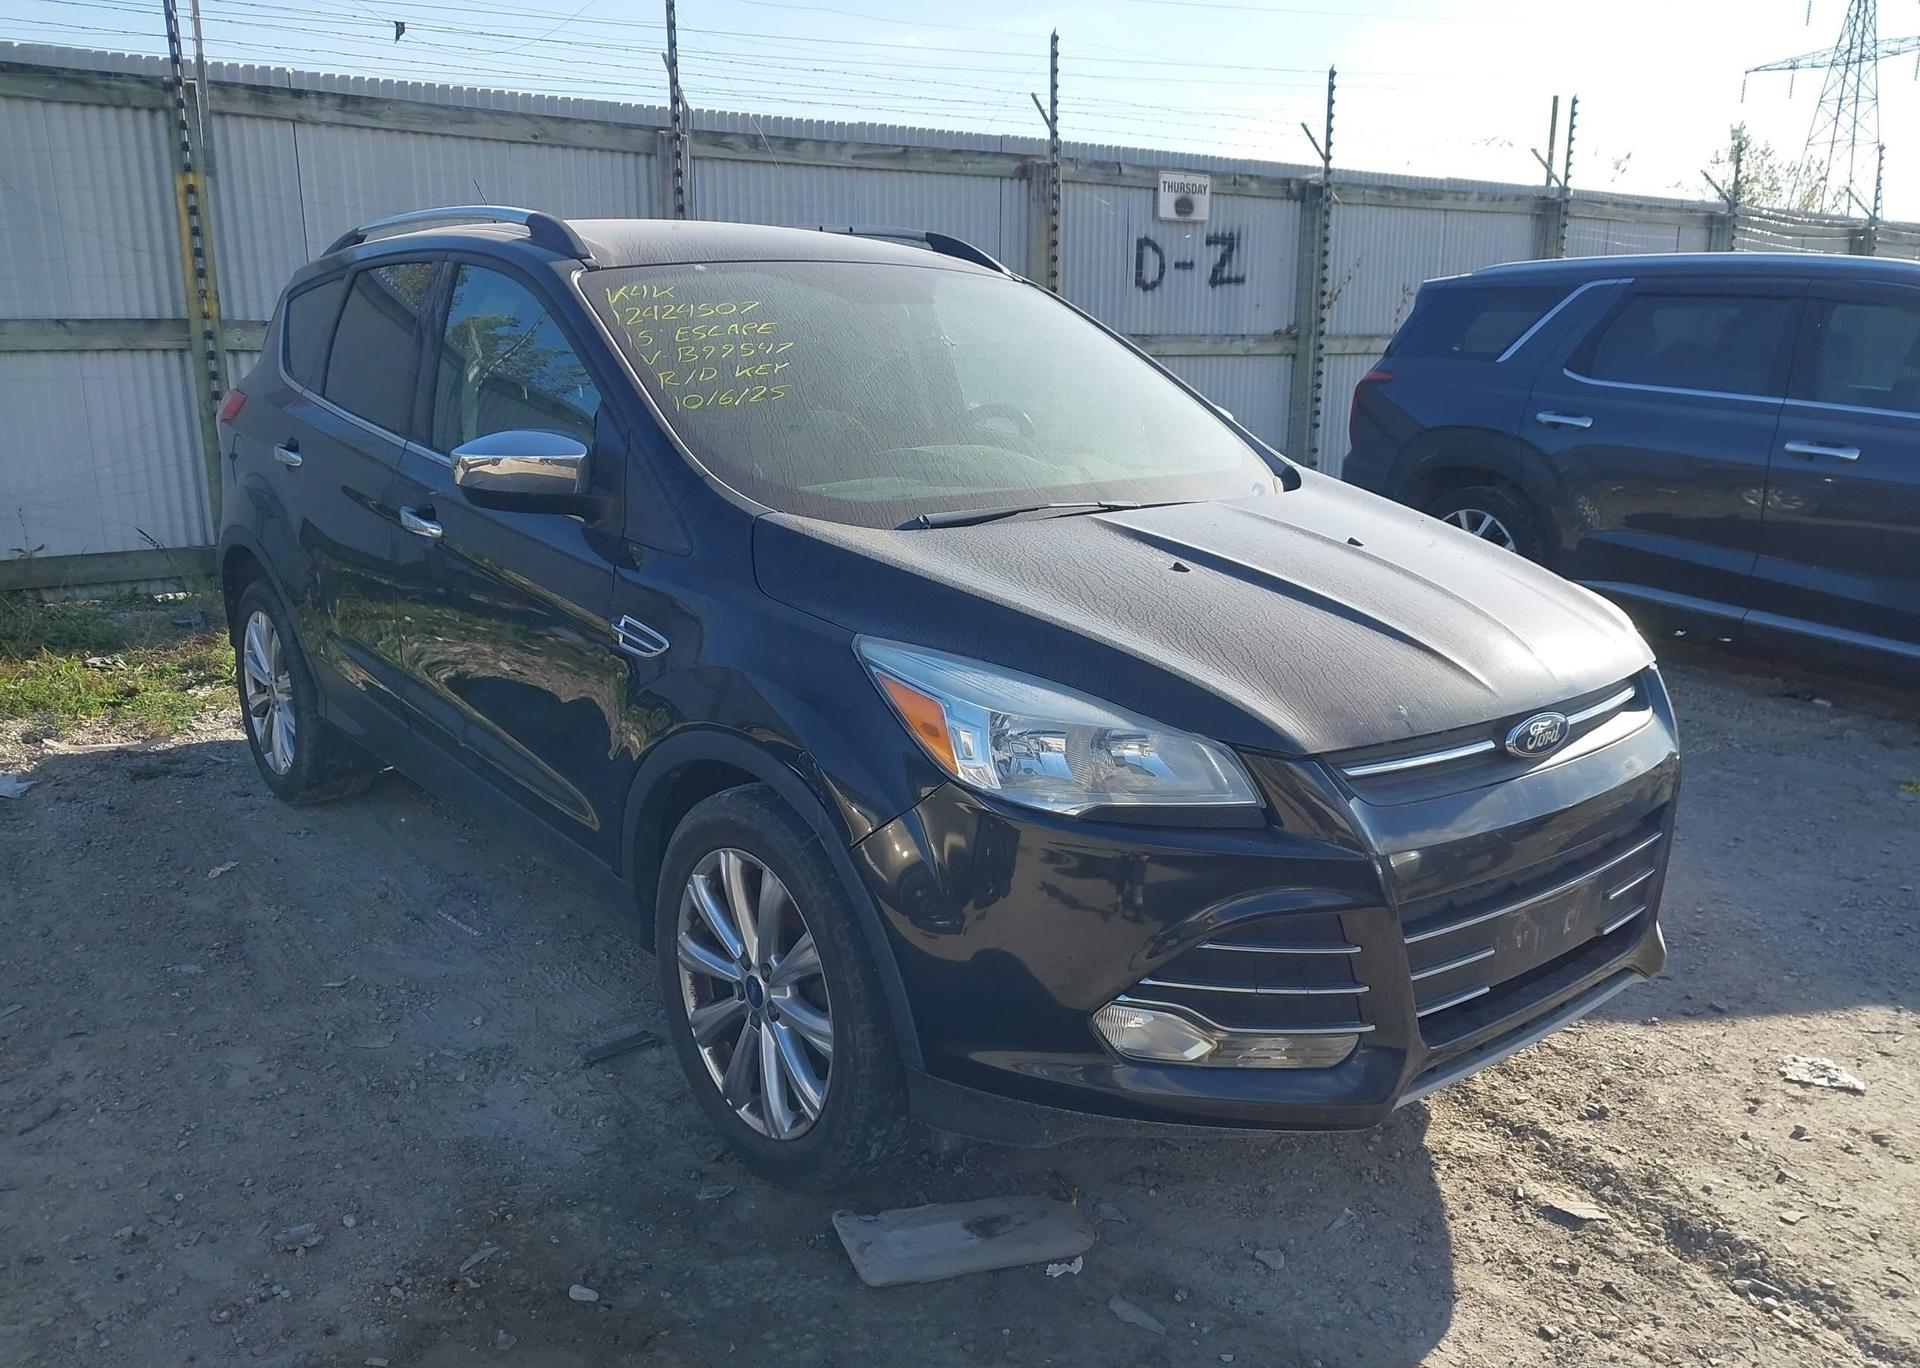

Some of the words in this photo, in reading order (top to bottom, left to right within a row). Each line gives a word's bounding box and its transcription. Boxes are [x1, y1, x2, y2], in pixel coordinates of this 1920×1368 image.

[1161, 180, 1208, 196] THURSDAY
[675, 321, 778, 342] ESCAPE
[735, 362, 790, 378] KEY
[674, 384, 793, 413] 10/6/25
[1526, 719, 1561, 751] Ford
